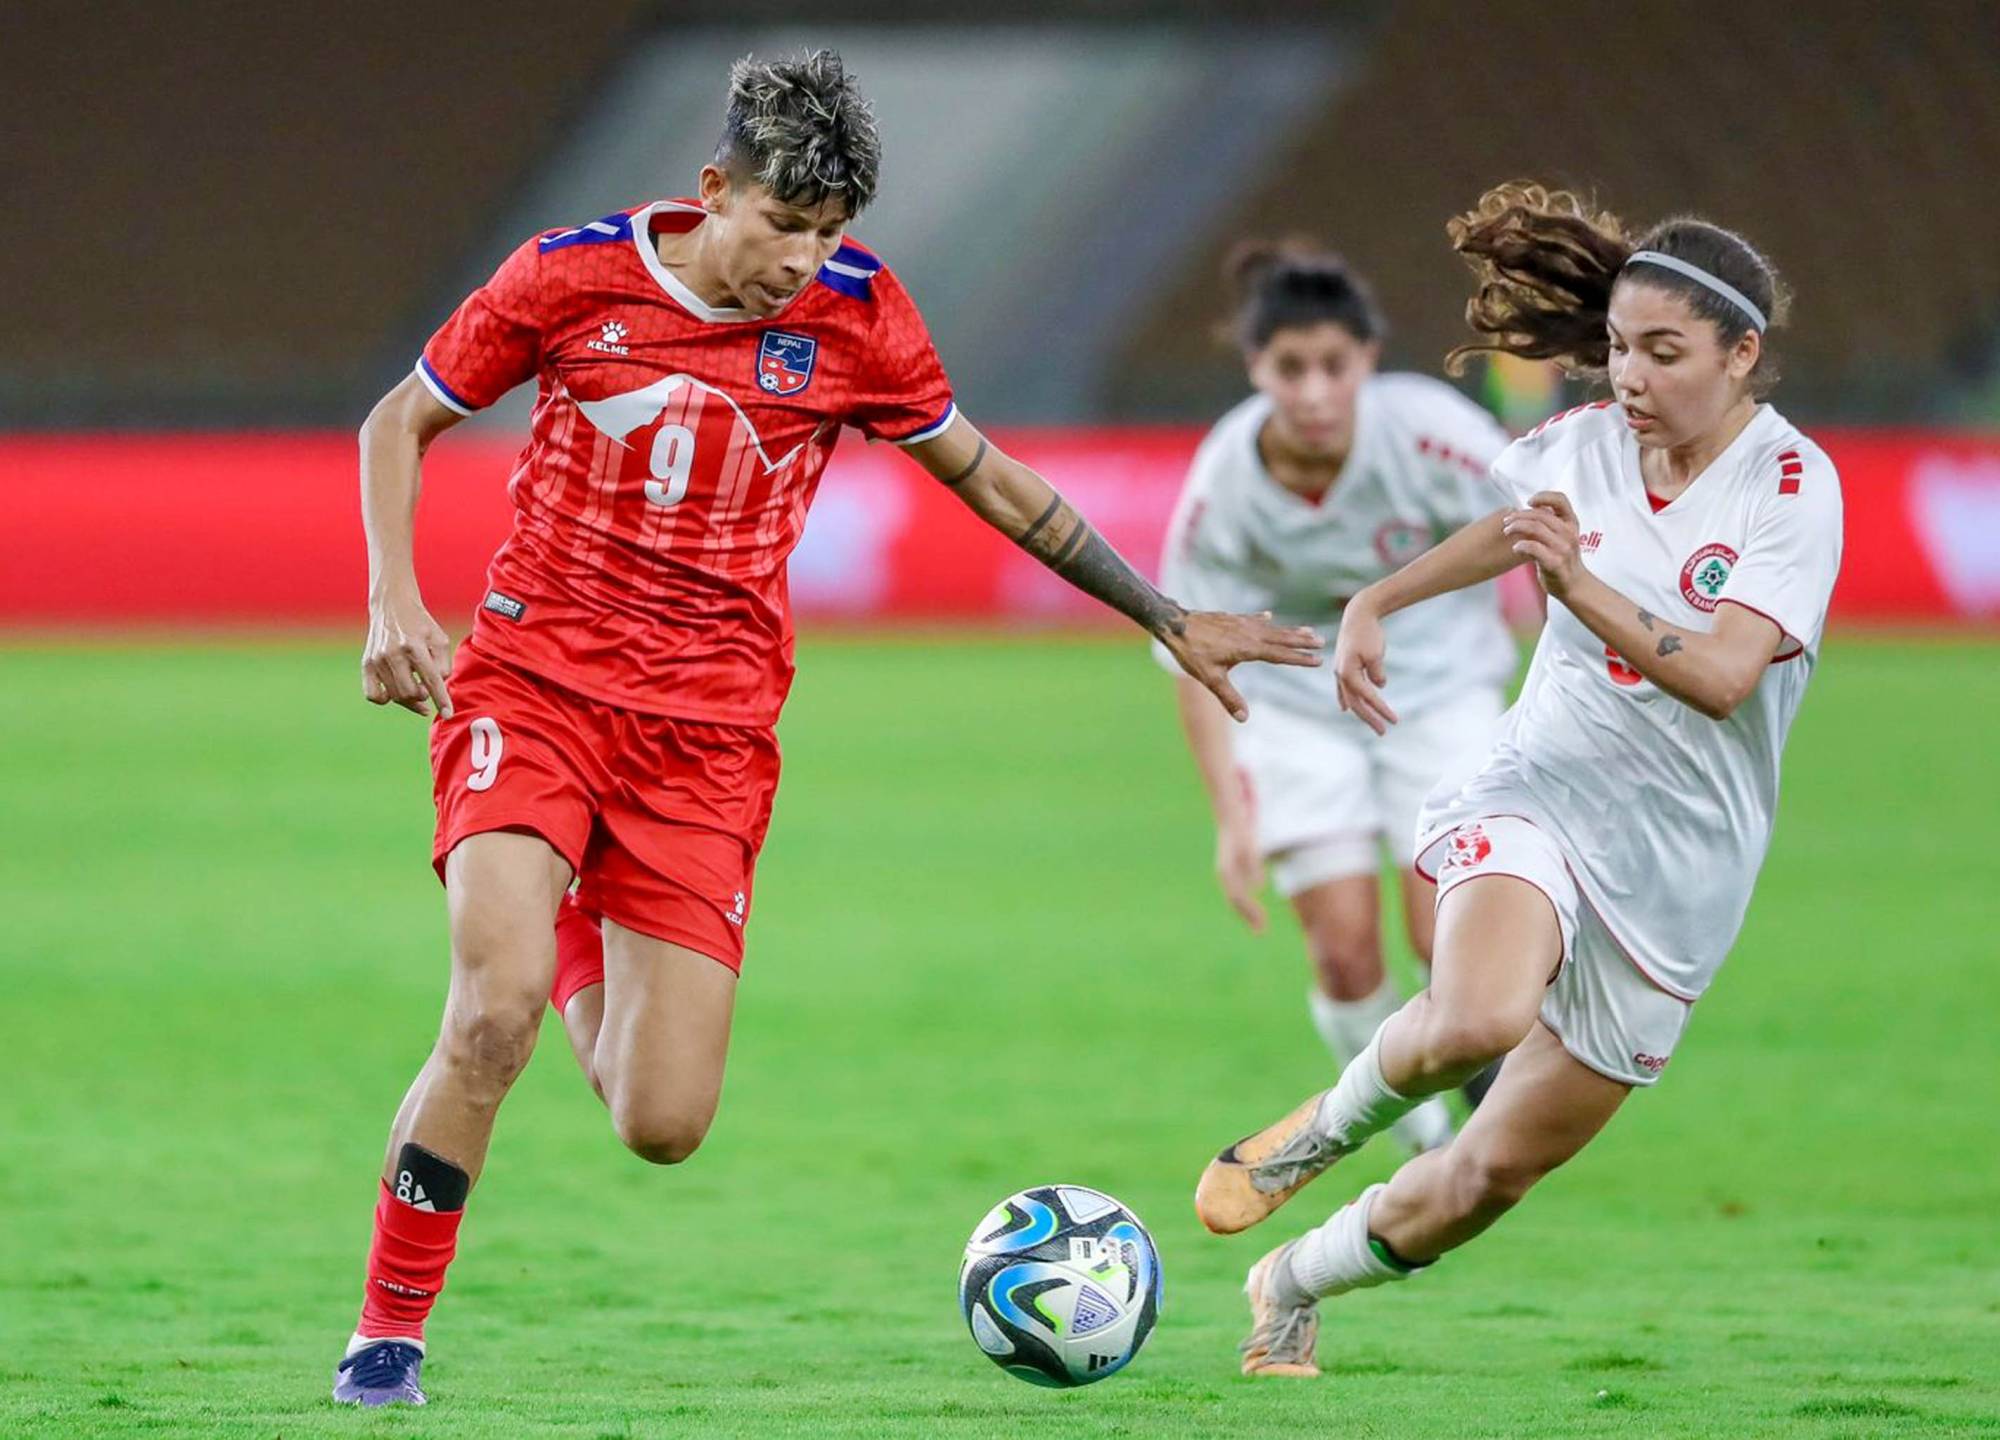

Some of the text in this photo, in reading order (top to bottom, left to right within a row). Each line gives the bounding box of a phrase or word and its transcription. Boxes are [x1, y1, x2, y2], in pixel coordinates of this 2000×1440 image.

[586, 340, 630, 356] KELME
[644, 424, 696, 507] 9
[1578, 530, 1603, 548] elli
[466, 716, 503, 791] 9
